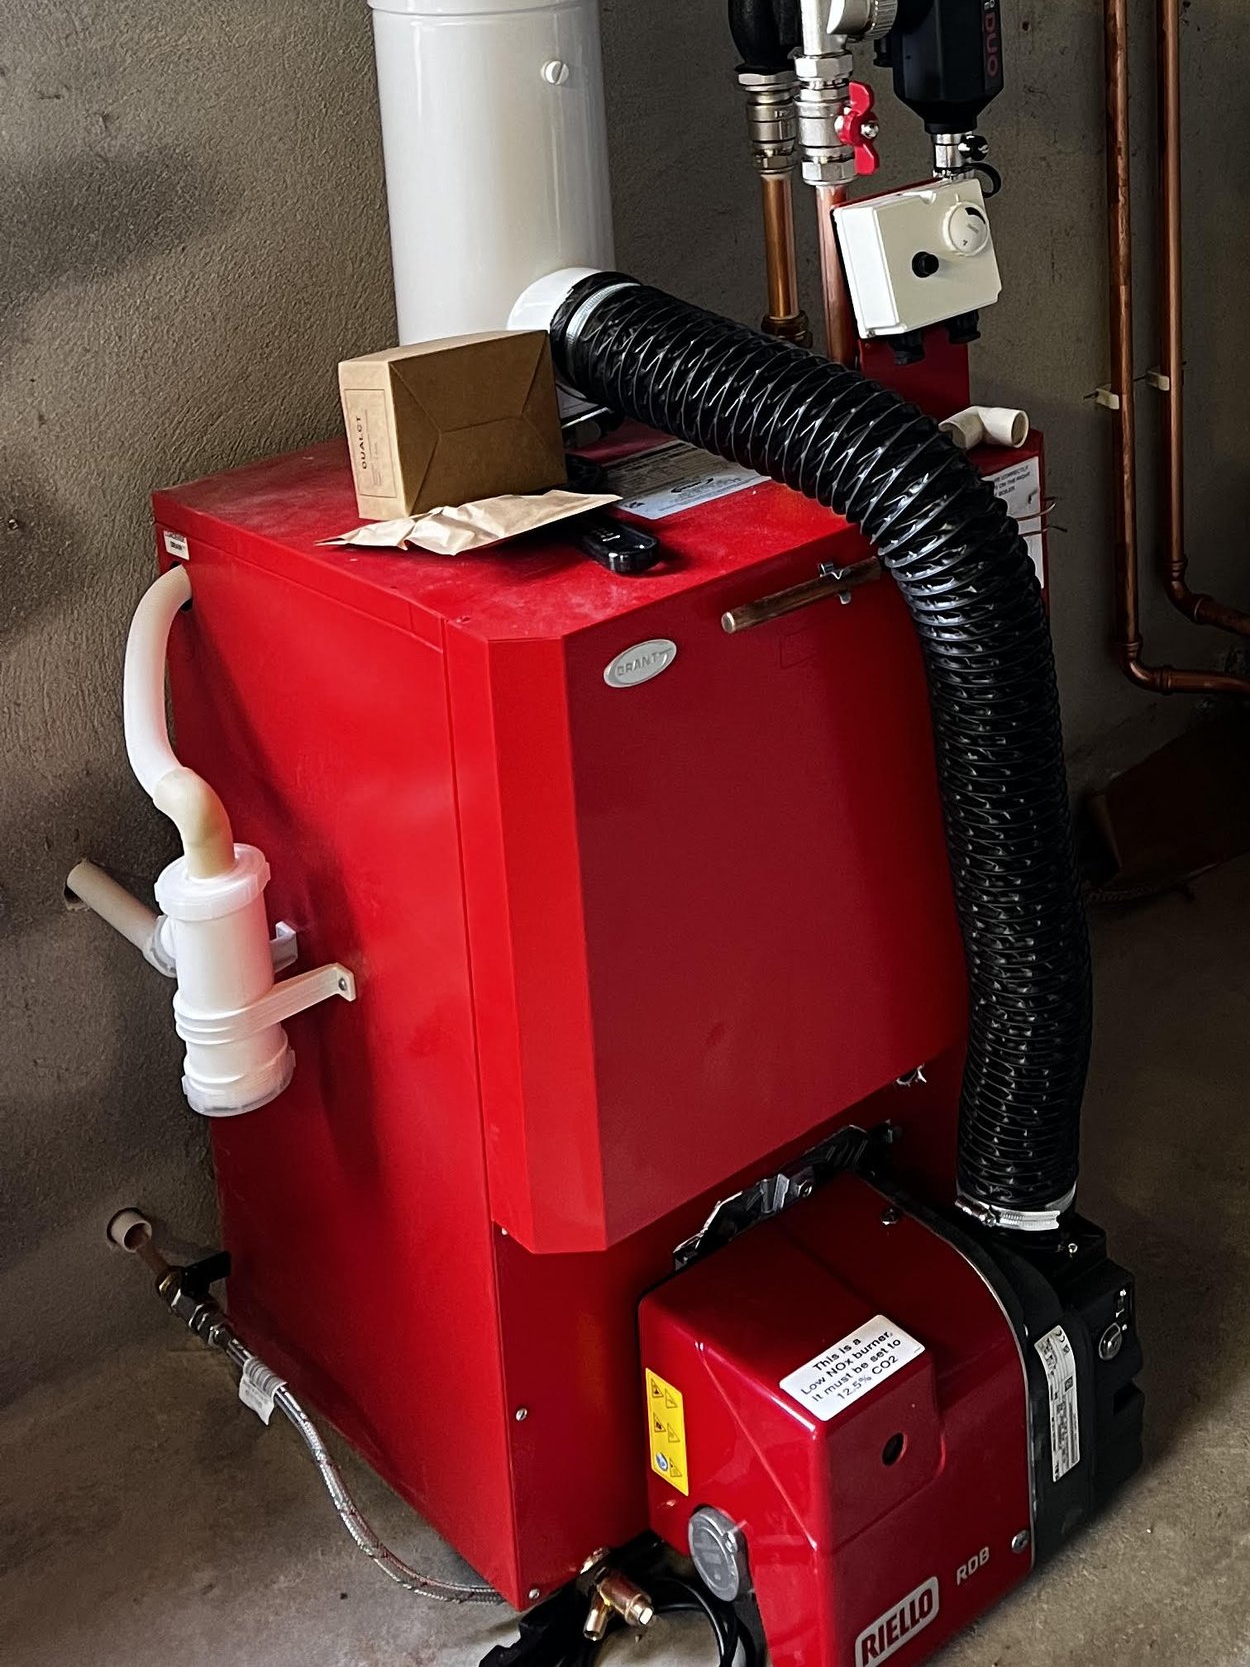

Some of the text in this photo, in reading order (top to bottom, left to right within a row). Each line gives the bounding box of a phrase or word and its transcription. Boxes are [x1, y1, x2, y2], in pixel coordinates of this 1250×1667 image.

[985, 13, 998, 77] DUO
[800, 1376, 826, 1395] Low
[826, 1358, 853, 1377] NOx
[811, 1339, 901, 1402] It must be set to
[812, 1338, 861, 1372] This is a
[837, 1355, 899, 1400] 12.5% CO2
[956, 1546, 990, 1586] RDB
[861, 1588, 933, 1667] RIELLO
